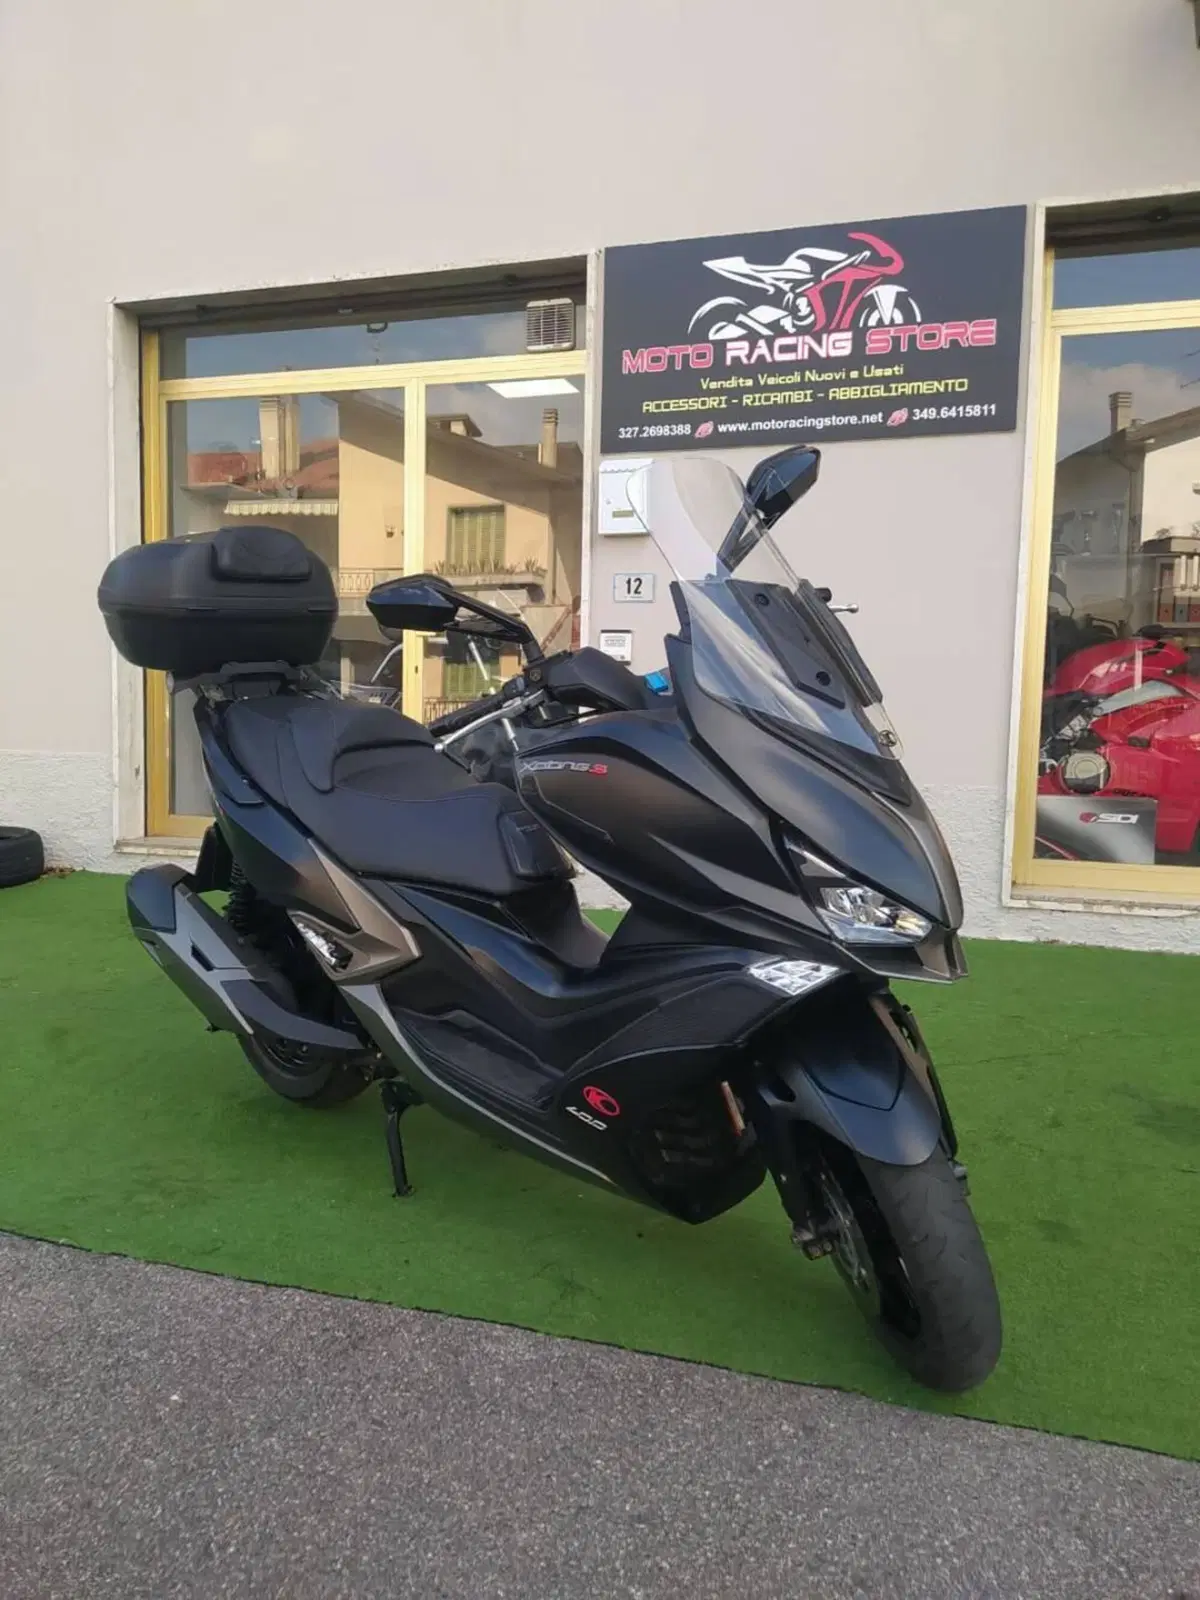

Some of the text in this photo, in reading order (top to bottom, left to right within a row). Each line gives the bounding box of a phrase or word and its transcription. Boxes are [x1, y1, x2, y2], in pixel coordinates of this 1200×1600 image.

[622, 319, 997, 374] MOTO RACING STORE
[701, 364, 905, 390] Vendita Veicoli Nuovi e Usati
[642, 396, 728, 413] ACCESSORI
[742, 389, 814, 408] RICAMBI
[829, 378, 969, 401] ABBIGLIAMENTO
[618, 403, 997, 439] 327.2698388 www.motoracingstore.net 349.6415811
[626, 577, 643, 595] 12
